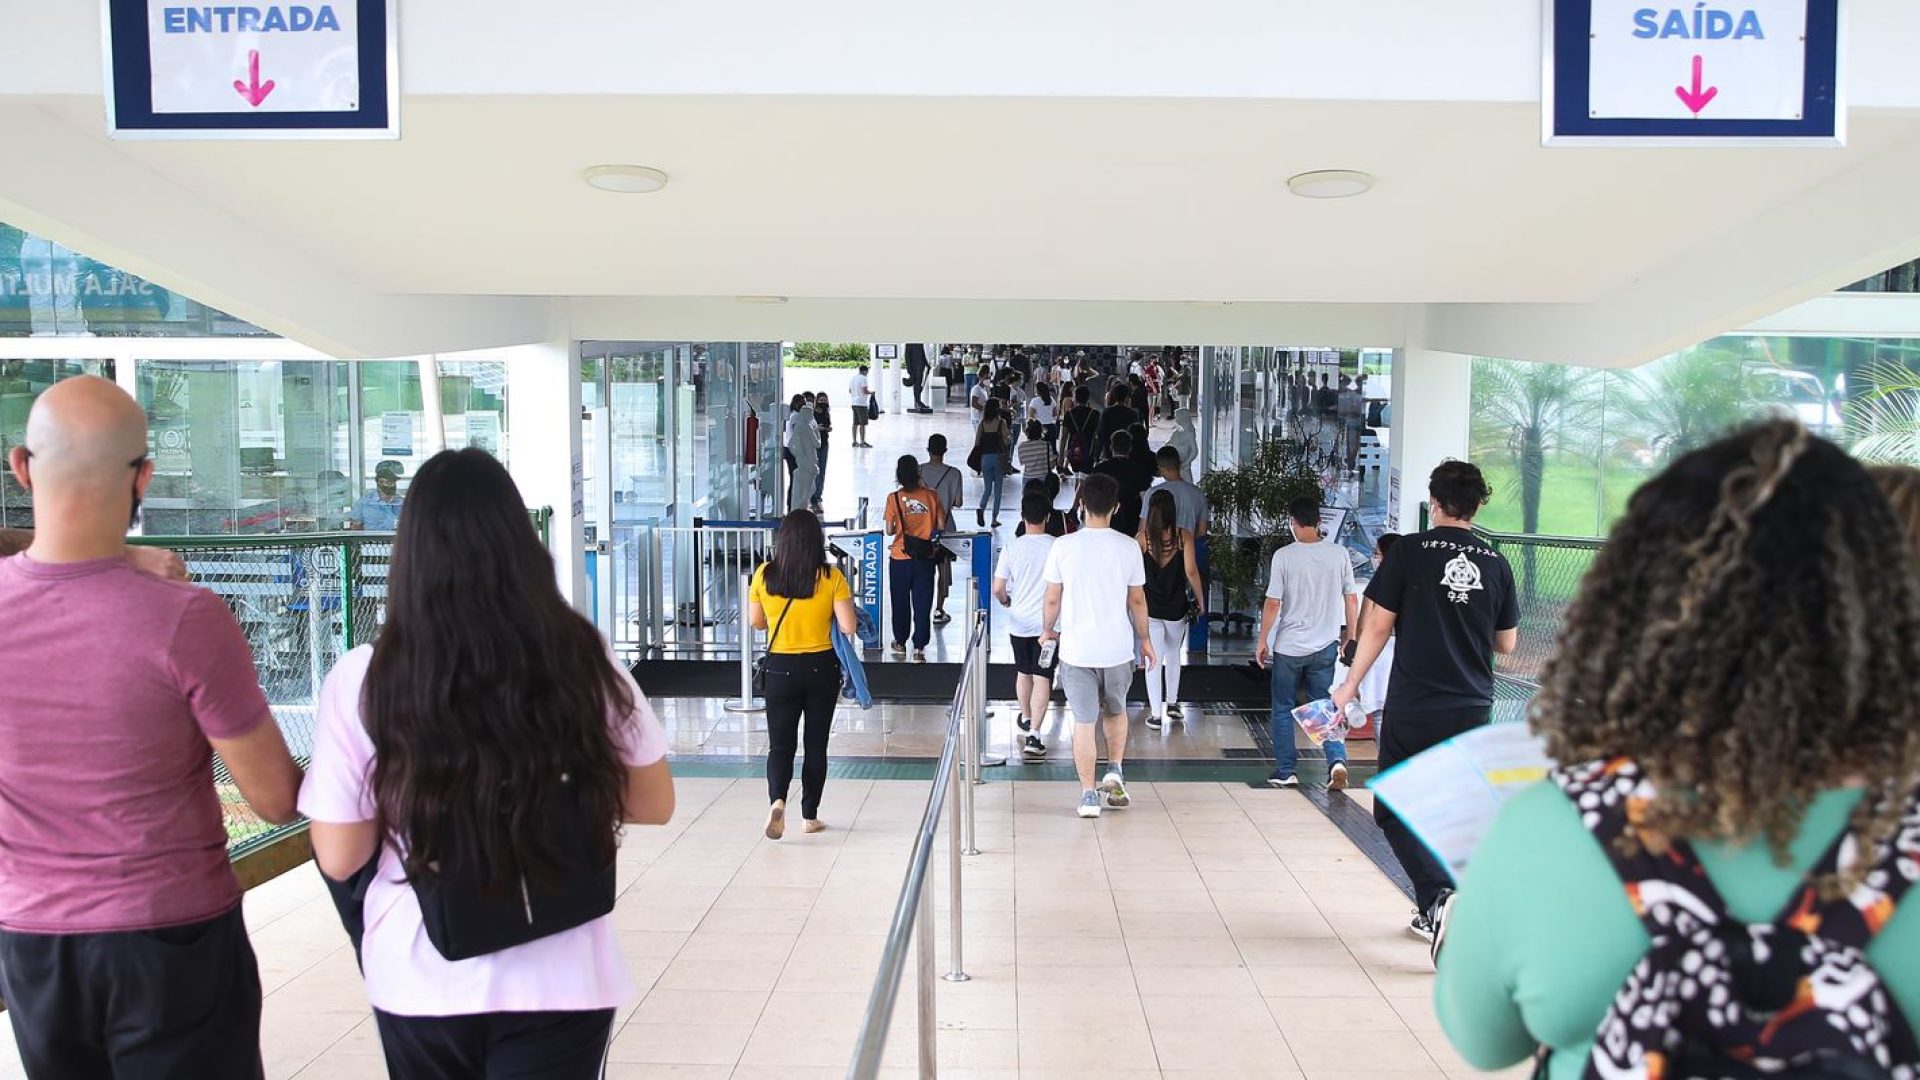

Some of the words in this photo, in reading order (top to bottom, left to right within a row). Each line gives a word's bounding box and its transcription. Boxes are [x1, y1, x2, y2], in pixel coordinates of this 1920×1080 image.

[163, 5, 341, 33] ENTRADA
[1632, 2, 1765, 40] SAÍDA
[865, 541, 877, 606] ENTRADA
